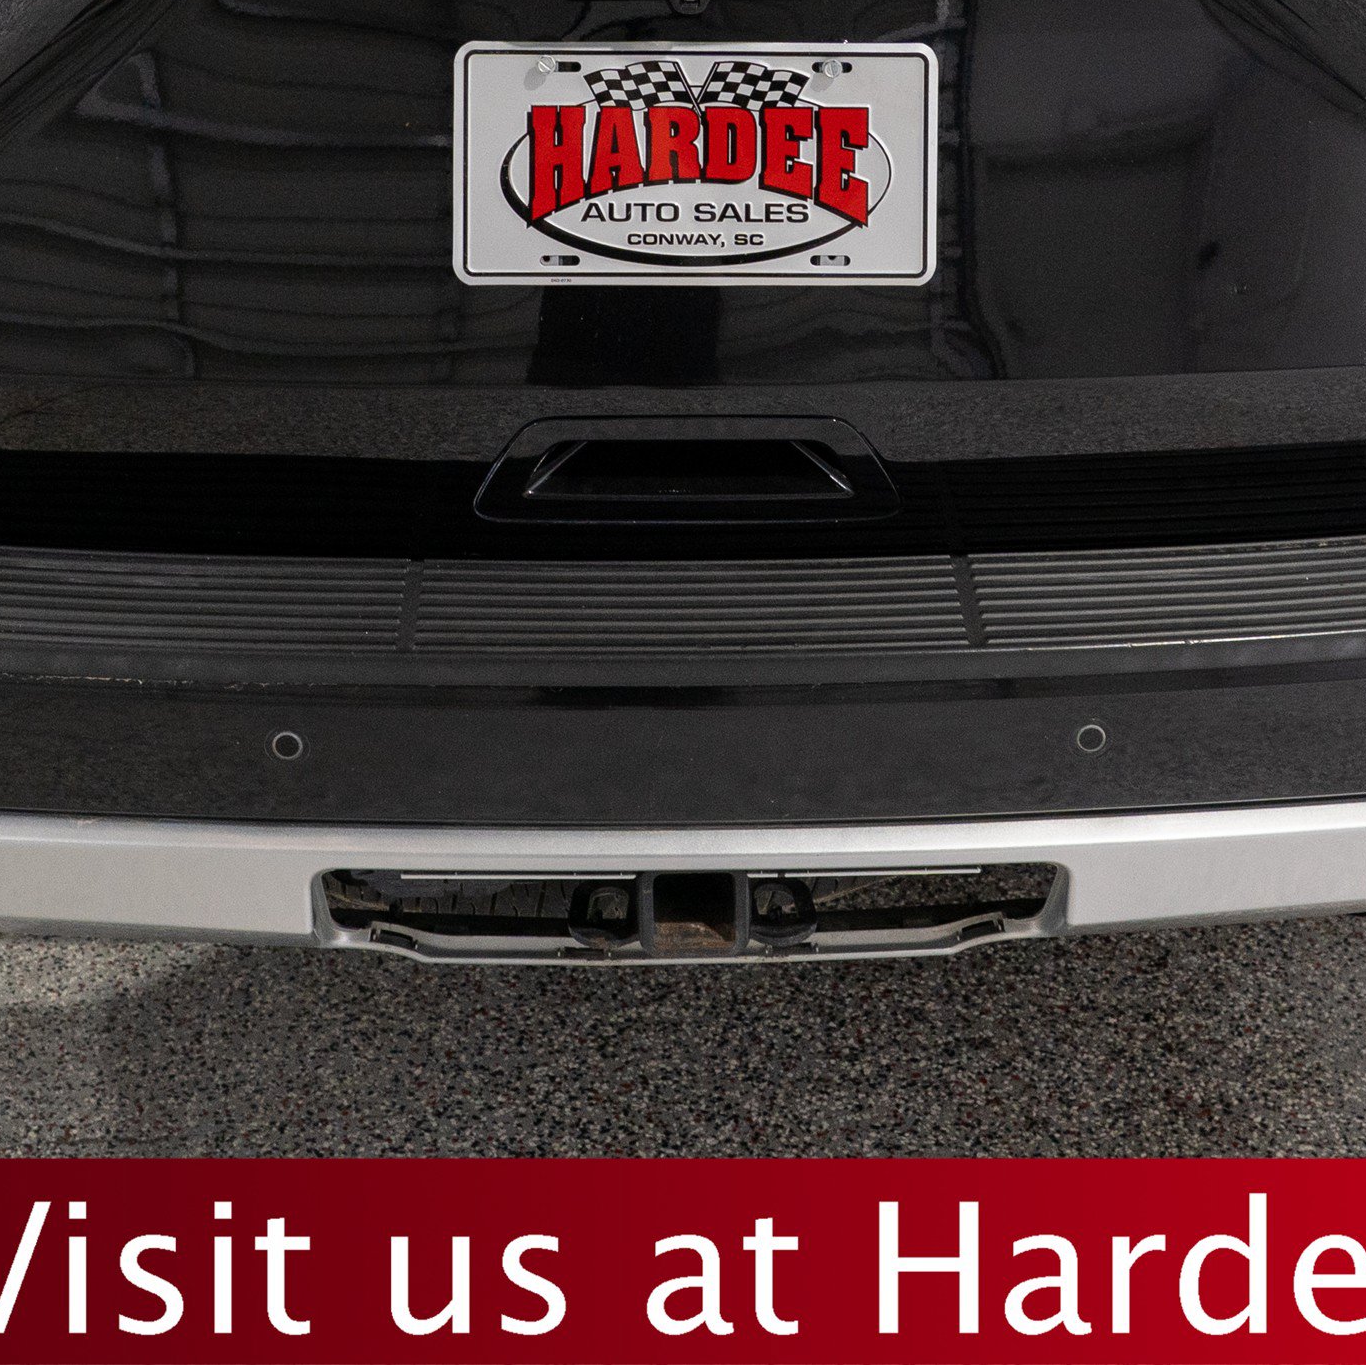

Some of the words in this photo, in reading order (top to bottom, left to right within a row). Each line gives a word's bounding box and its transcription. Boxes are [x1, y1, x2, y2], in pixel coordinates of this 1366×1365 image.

[526, 104, 870, 228] HARDEE
[580, 202, 681, 224] AUTO
[693, 202, 810, 224] SALES
[626, 232, 727, 249] CONWAY,
[734, 232, 764, 247] SC
